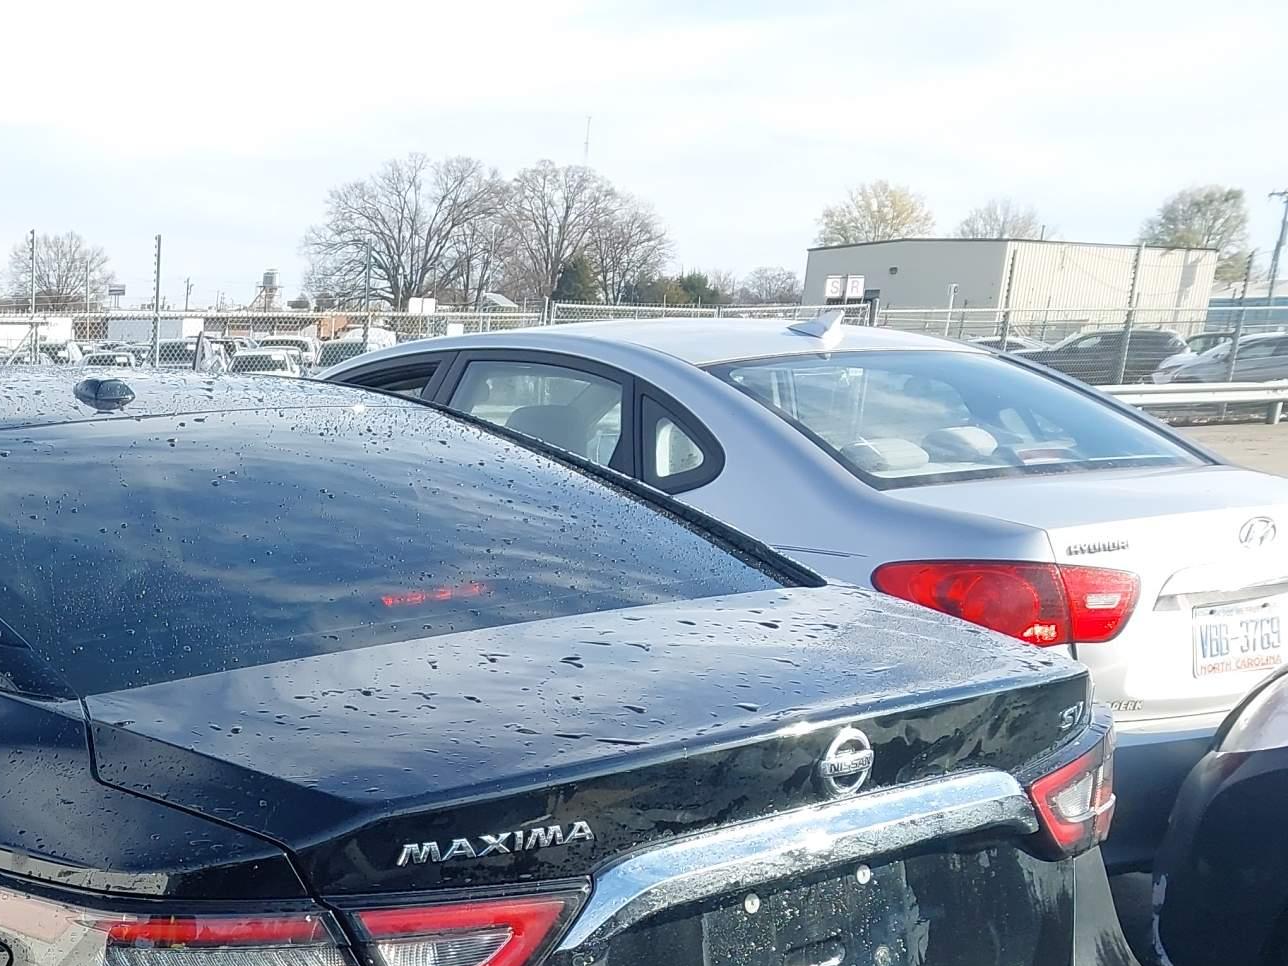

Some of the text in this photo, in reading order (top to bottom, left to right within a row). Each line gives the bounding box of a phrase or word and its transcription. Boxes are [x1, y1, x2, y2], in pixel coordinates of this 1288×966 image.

[1200, 653, 1283, 676] NORTH CAROLINA
[1056, 700, 1085, 729] SV
[829, 755, 872, 773] NISSAN
[396, 820, 595, 867] MAXIMA
